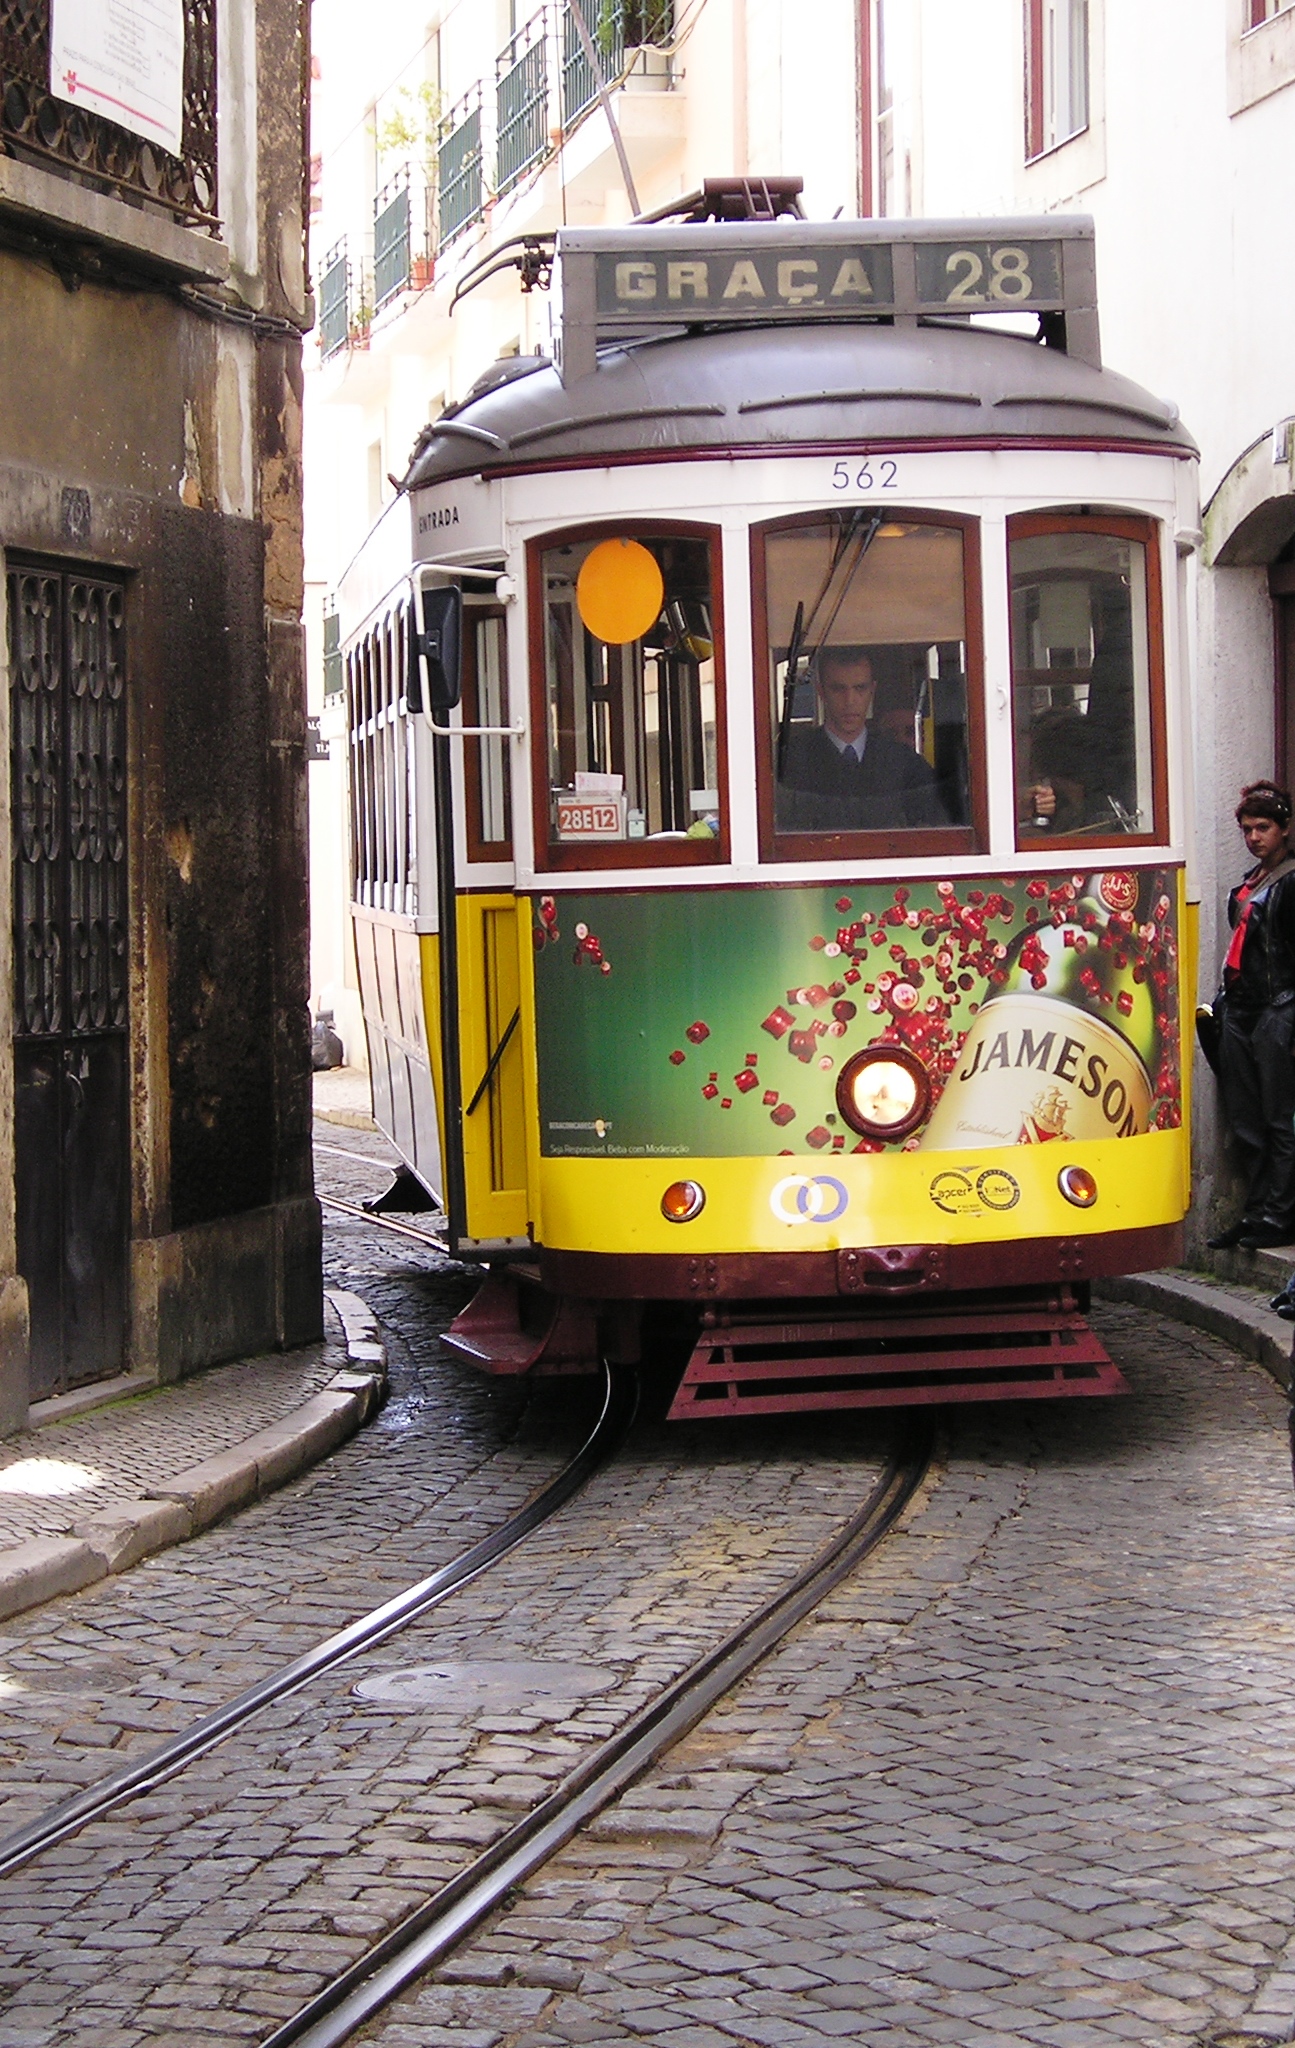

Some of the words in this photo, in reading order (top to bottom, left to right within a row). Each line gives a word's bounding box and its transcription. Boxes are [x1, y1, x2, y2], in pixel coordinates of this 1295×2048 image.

[614, 258, 874, 304] GRAÇA
[945, 246, 1033, 303] 28
[832, 460, 898, 490] 562
[419, 506, 459, 534] ENTRADA
[607, 1144, 627, 1154] Beba
[646, 1144, 690, 1155] Moderação
